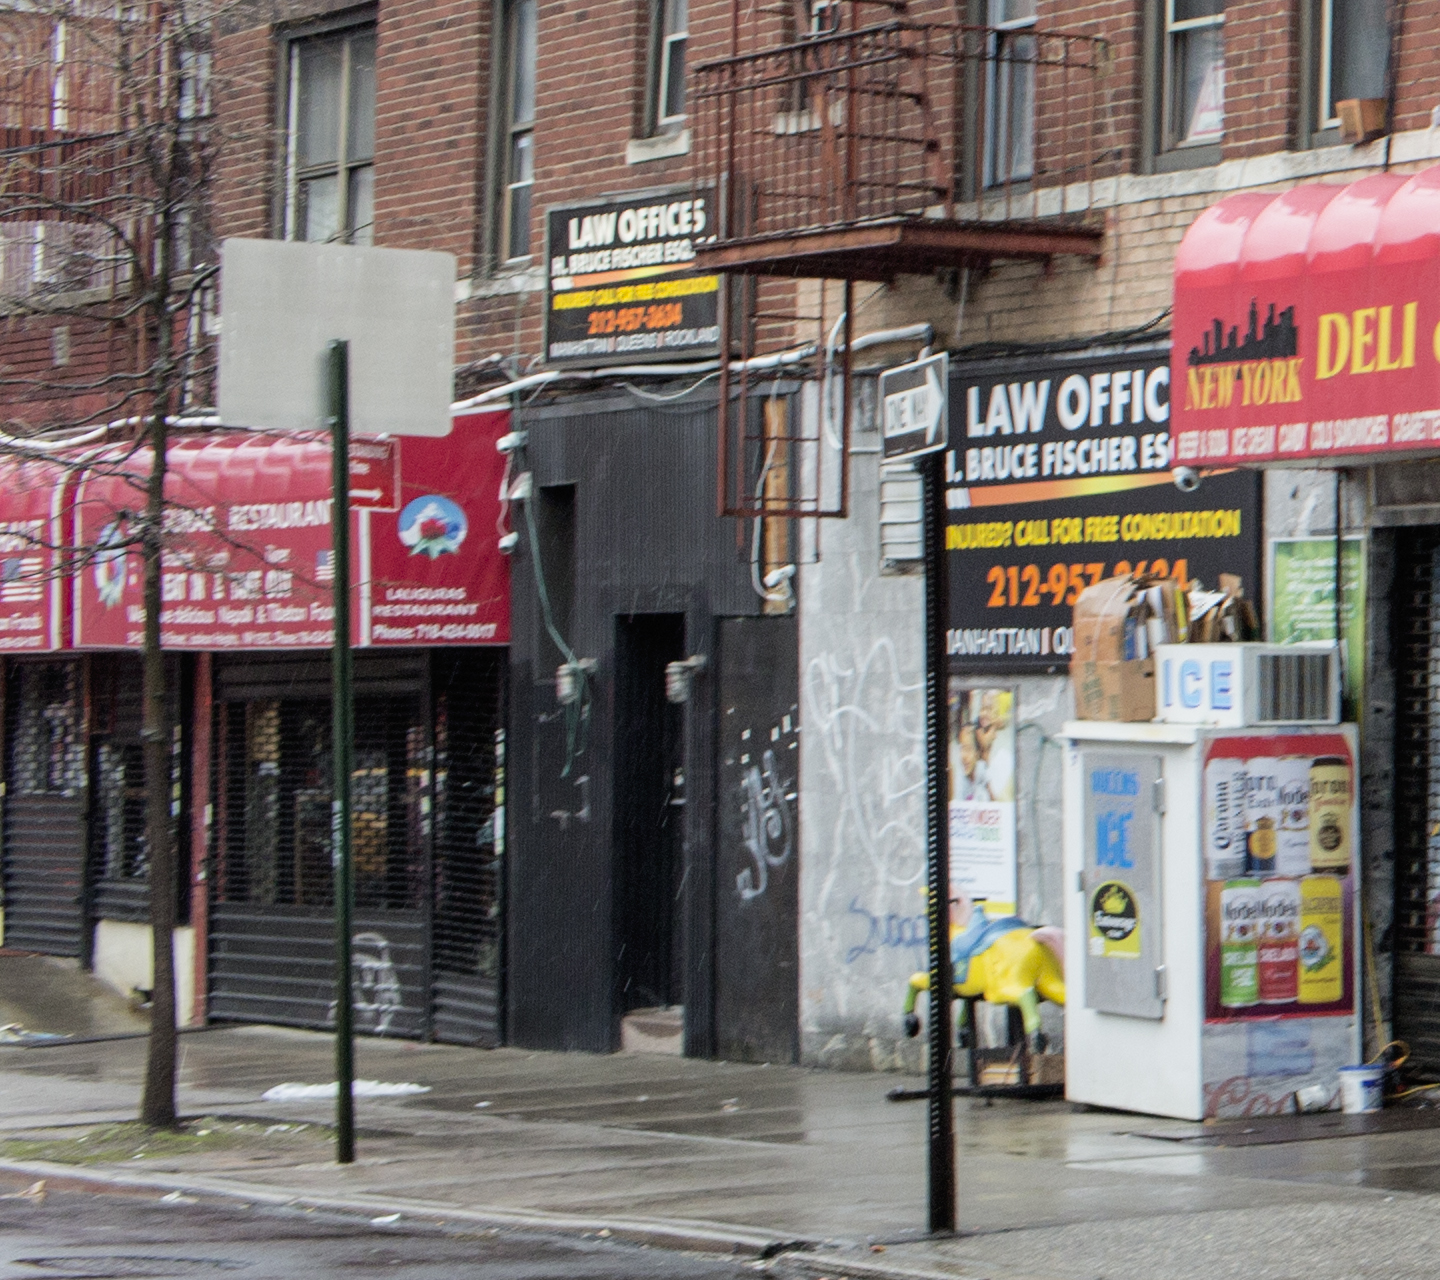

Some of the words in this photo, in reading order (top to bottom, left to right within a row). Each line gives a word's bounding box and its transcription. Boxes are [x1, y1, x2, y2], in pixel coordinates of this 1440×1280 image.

[569, 211, 618, 250] LAW
[618, 198, 707, 244] OFFICES
[1315, 300, 1419, 380] DELI
[966, 379, 1051, 439] LAW
[1057, 366, 1170, 431] OFFIC
[1184, 361, 1235, 412] NEW
[1236, 356, 1305, 407] YORK
[966, 443, 1038, 482] BRUCE
[1043, 436, 1138, 477] FISCHER
[1141, 432, 1172, 469] ES
[1014, 519, 1050, 547] CALL
[1051, 517, 1082, 545] FOR
[1084, 515, 1120, 544] FREE
[1121, 509, 1241, 543] CONSULTATION
[1163, 658, 1234, 711] ICE
